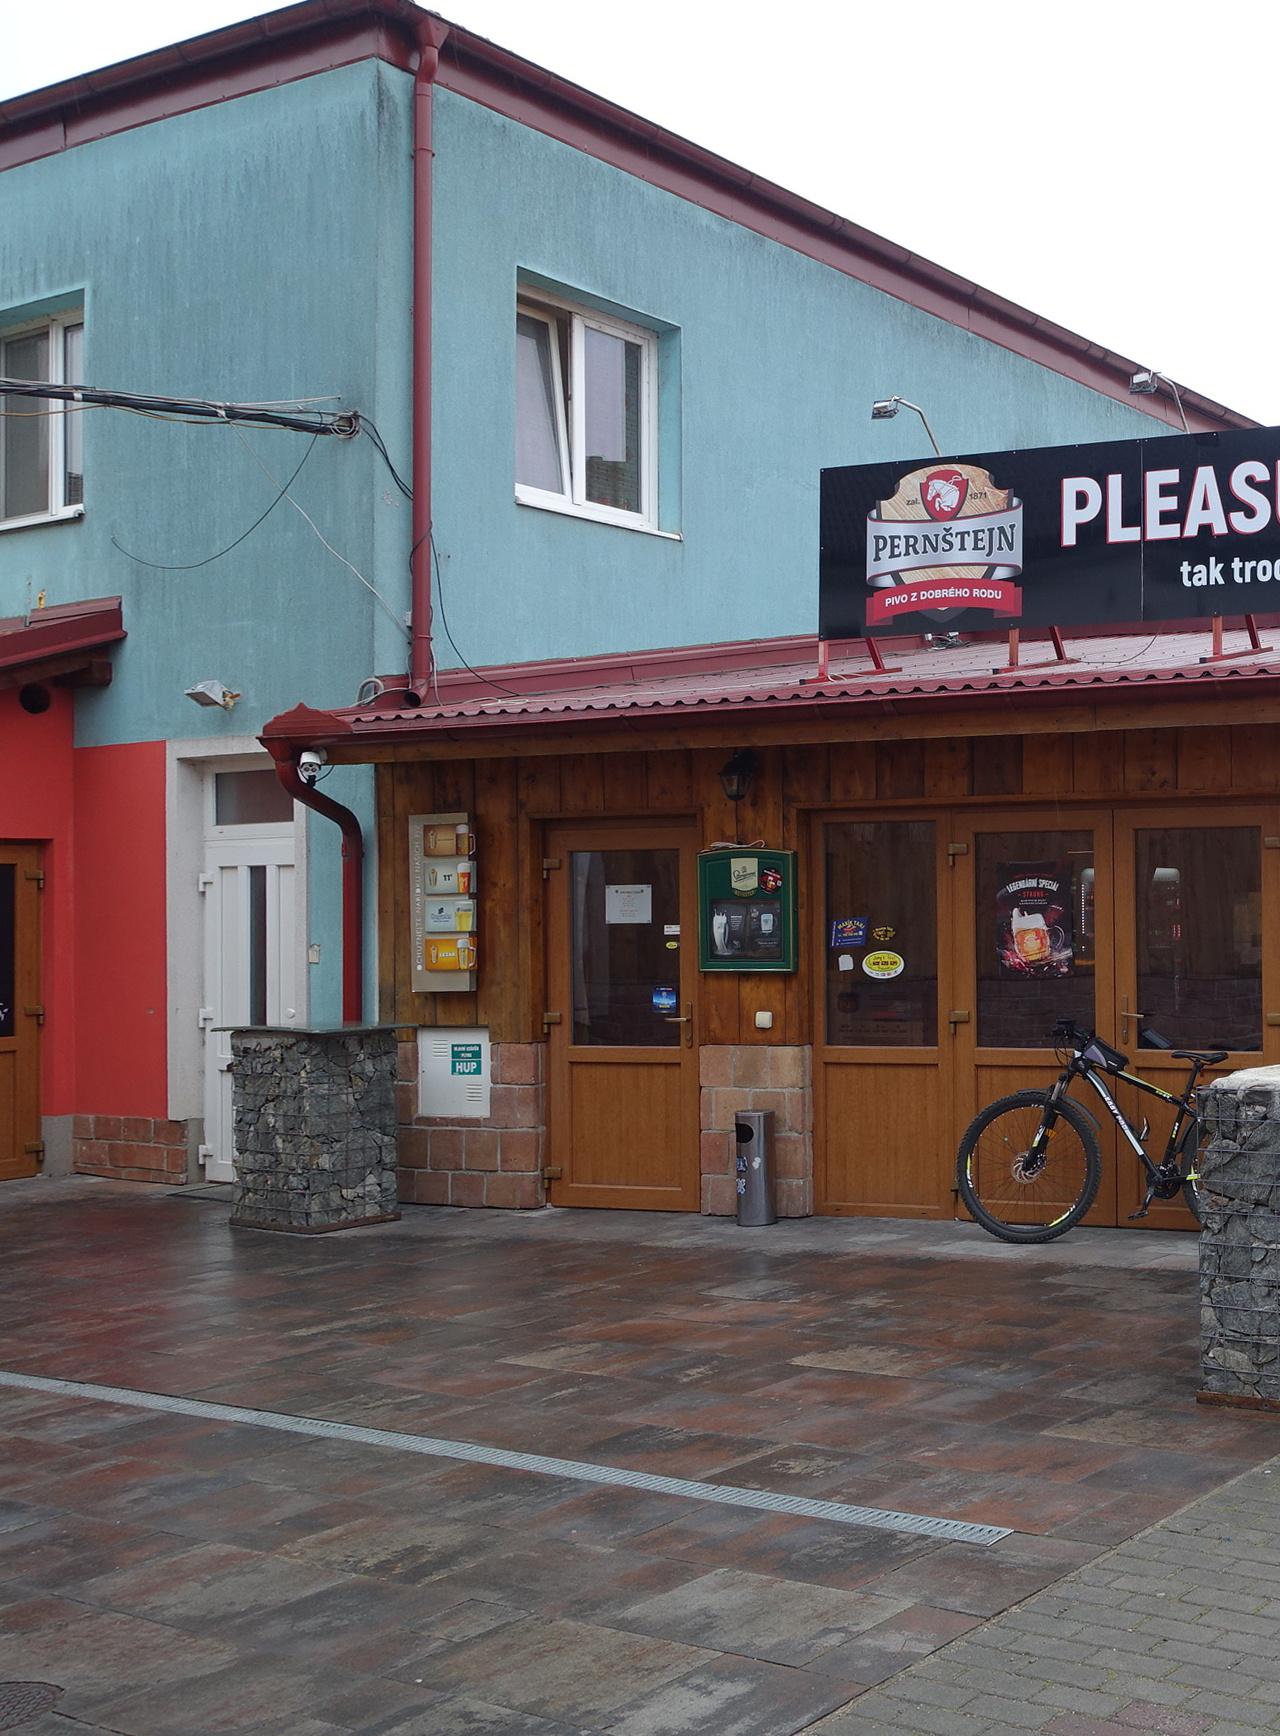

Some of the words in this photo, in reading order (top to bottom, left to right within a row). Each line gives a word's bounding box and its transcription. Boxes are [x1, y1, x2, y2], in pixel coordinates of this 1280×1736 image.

[969, 491, 988, 500] 1871
[873, 523, 1016, 562] PERNŠTEJN
[1180, 555, 1224, 587] tak
[885, 593, 908, 607] PIVO
[910, 592, 918, 601] Z
[920, 587, 970, 600] DOBRÉHO
[973, 588, 1002, 600] RODU
[456, 1061, 477, 1073] HUP
